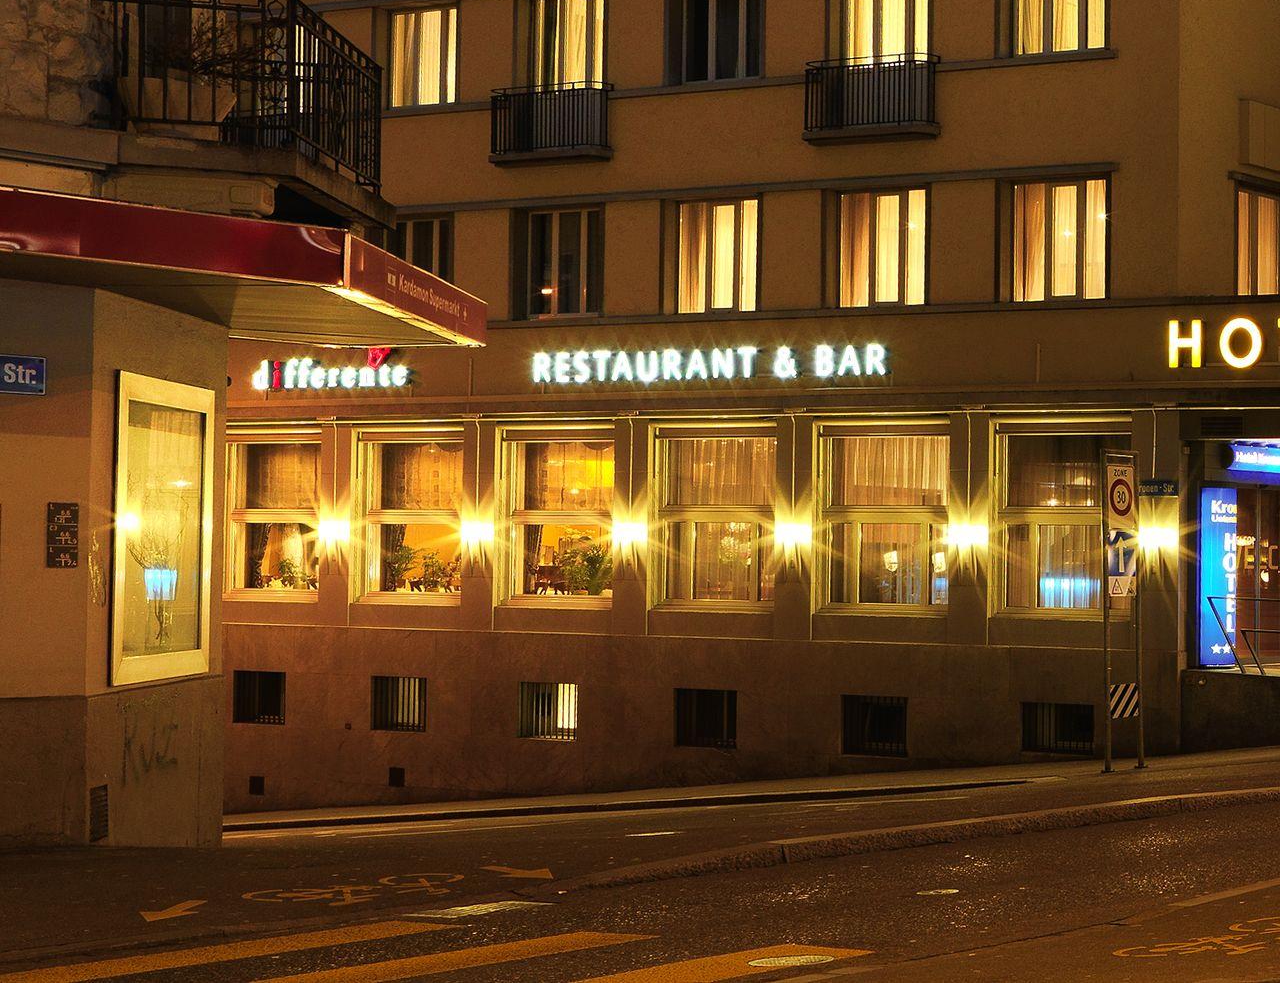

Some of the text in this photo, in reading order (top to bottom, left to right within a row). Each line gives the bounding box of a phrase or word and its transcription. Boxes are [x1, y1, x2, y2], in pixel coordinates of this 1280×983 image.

[399, 273, 460, 318] Kardamon Supermarkt
[4, 363, 37, 384] Str.
[251, 359, 411, 390] differente
[531, 343, 887, 383] RESTAURANT & BAR
[1113, 468, 1128, 477] ZONE
[1116, 490, 1126, 504] 30
